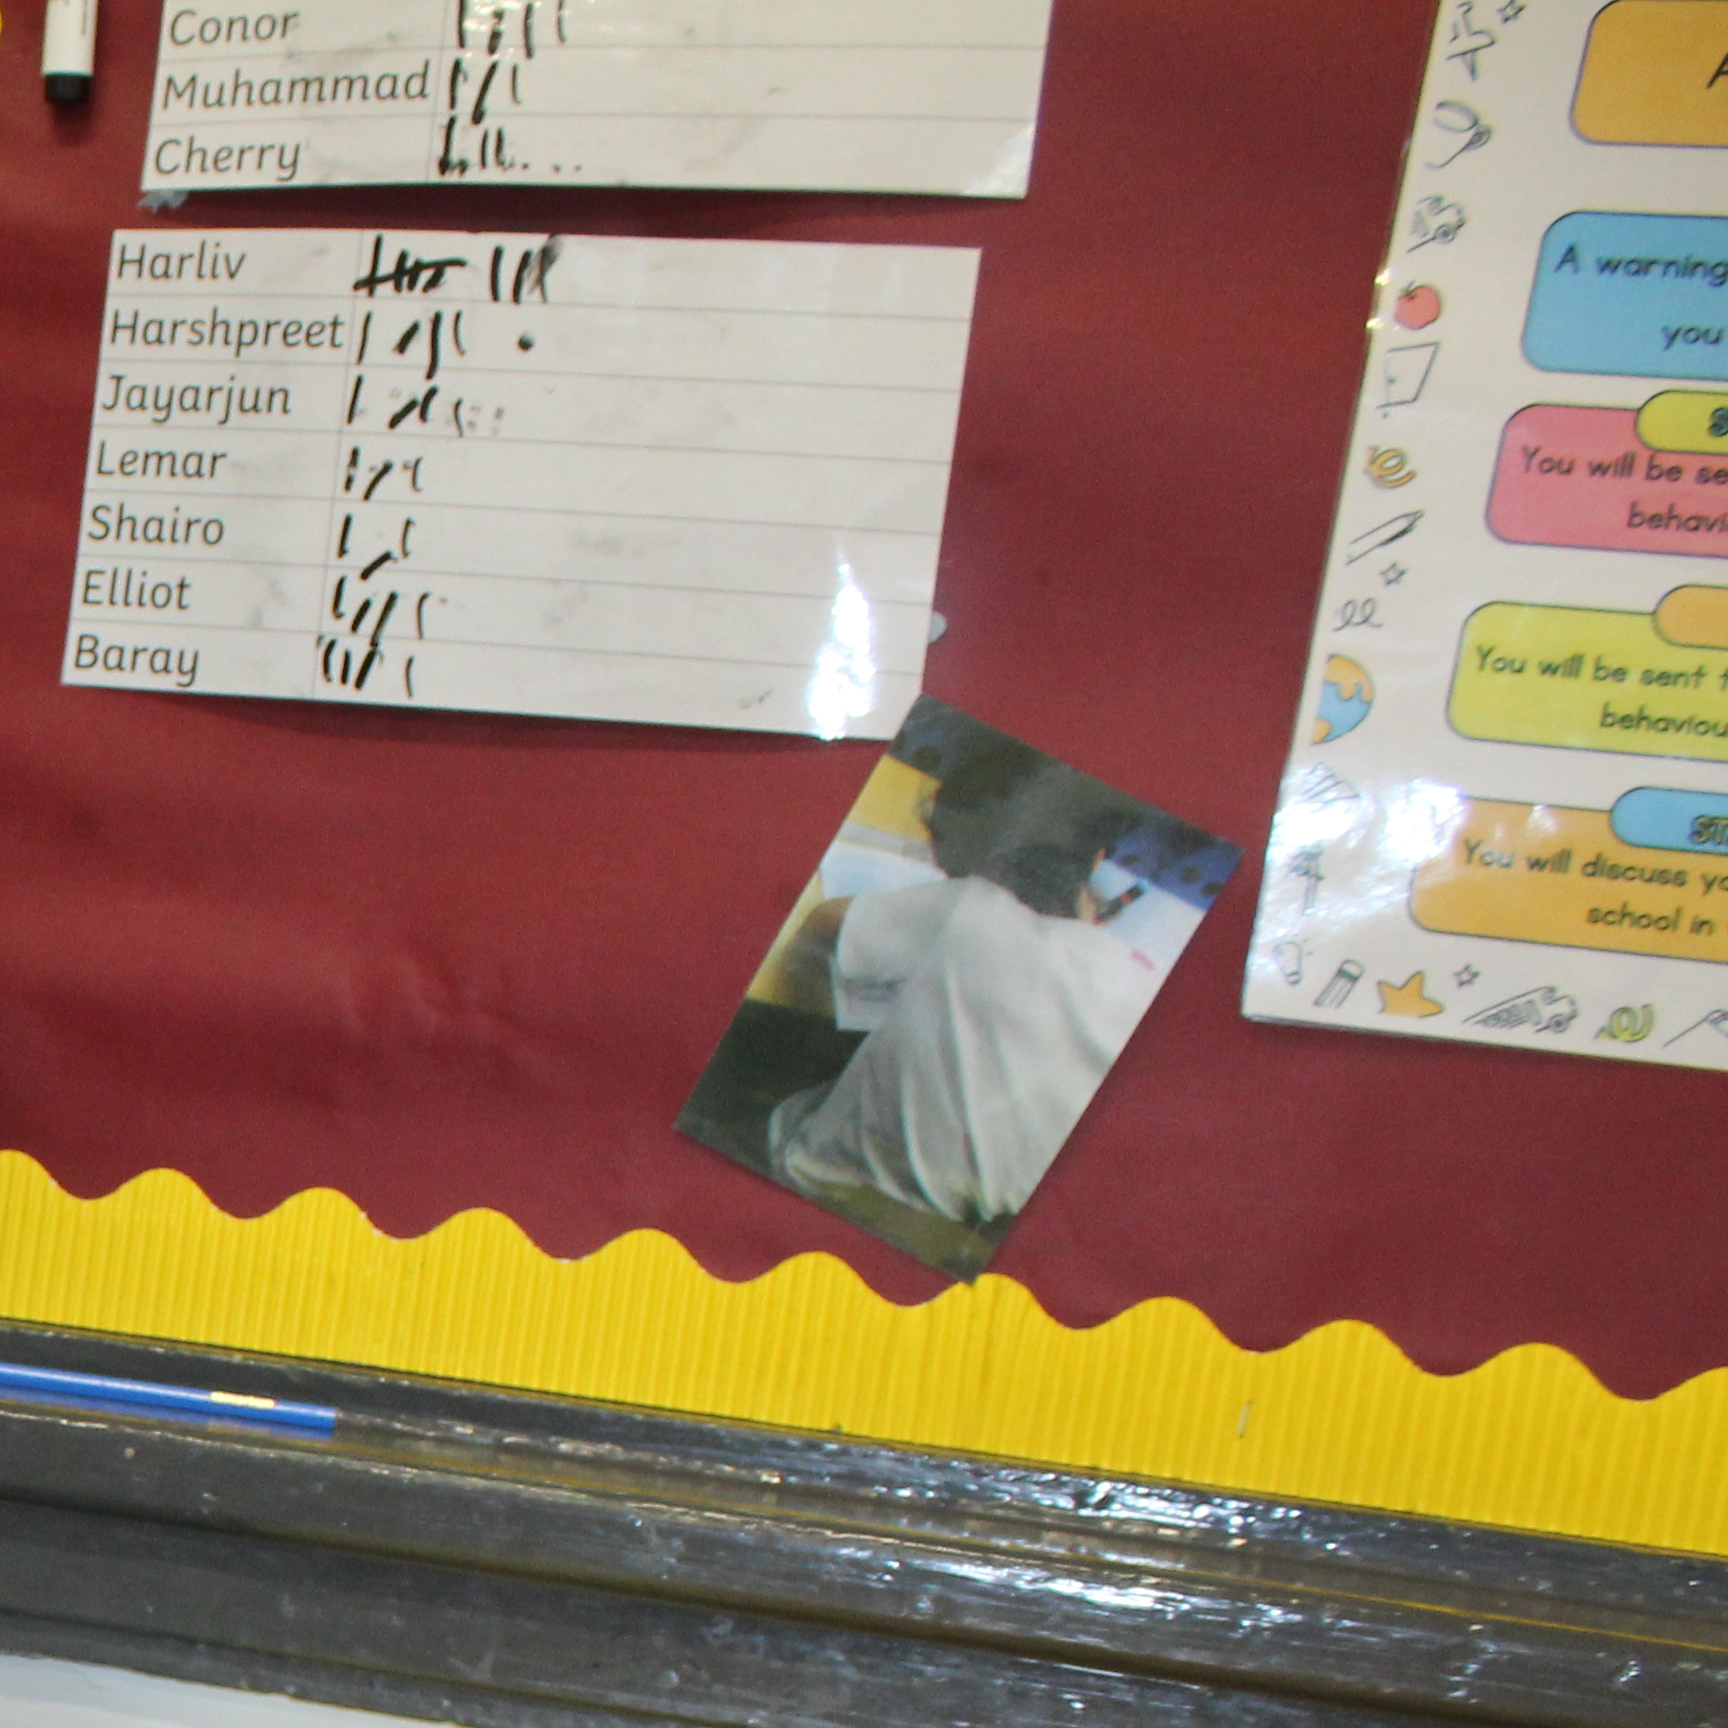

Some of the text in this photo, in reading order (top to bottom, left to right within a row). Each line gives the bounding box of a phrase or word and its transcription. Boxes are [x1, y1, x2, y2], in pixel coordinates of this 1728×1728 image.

[170, 8, 300, 46] Conor
[161, 58, 431, 110] Muhammad
[154, 134, 301, 182] Cherry
[116, 238, 247, 281] Harliv
[1553, 243, 1728, 288] A warning
[110, 305, 347, 358] Harshpreet
[1661, 324, 1725, 351] you
[102, 373, 292, 426] Jayarjun
[96, 439, 228, 479] Lemar
[1523, 445, 1576, 476] You
[1589, 450, 1636, 478] will
[1646, 452, 1683, 482] be
[88, 502, 225, 546] Shairo
[82, 567, 191, 610] Elliot
[74, 633, 199, 688] Baray
[1477, 645, 1528, 675] You
[1539, 653, 1585, 679] will
[1593, 655, 1629, 683] be
[1641, 665, 1707, 689] sent
[1465, 838, 1515, 869] You
[1527, 849, 1572, 875] will
[1581, 853, 1689, 887] discuss
[1587, 902, 1715, 936] school in
